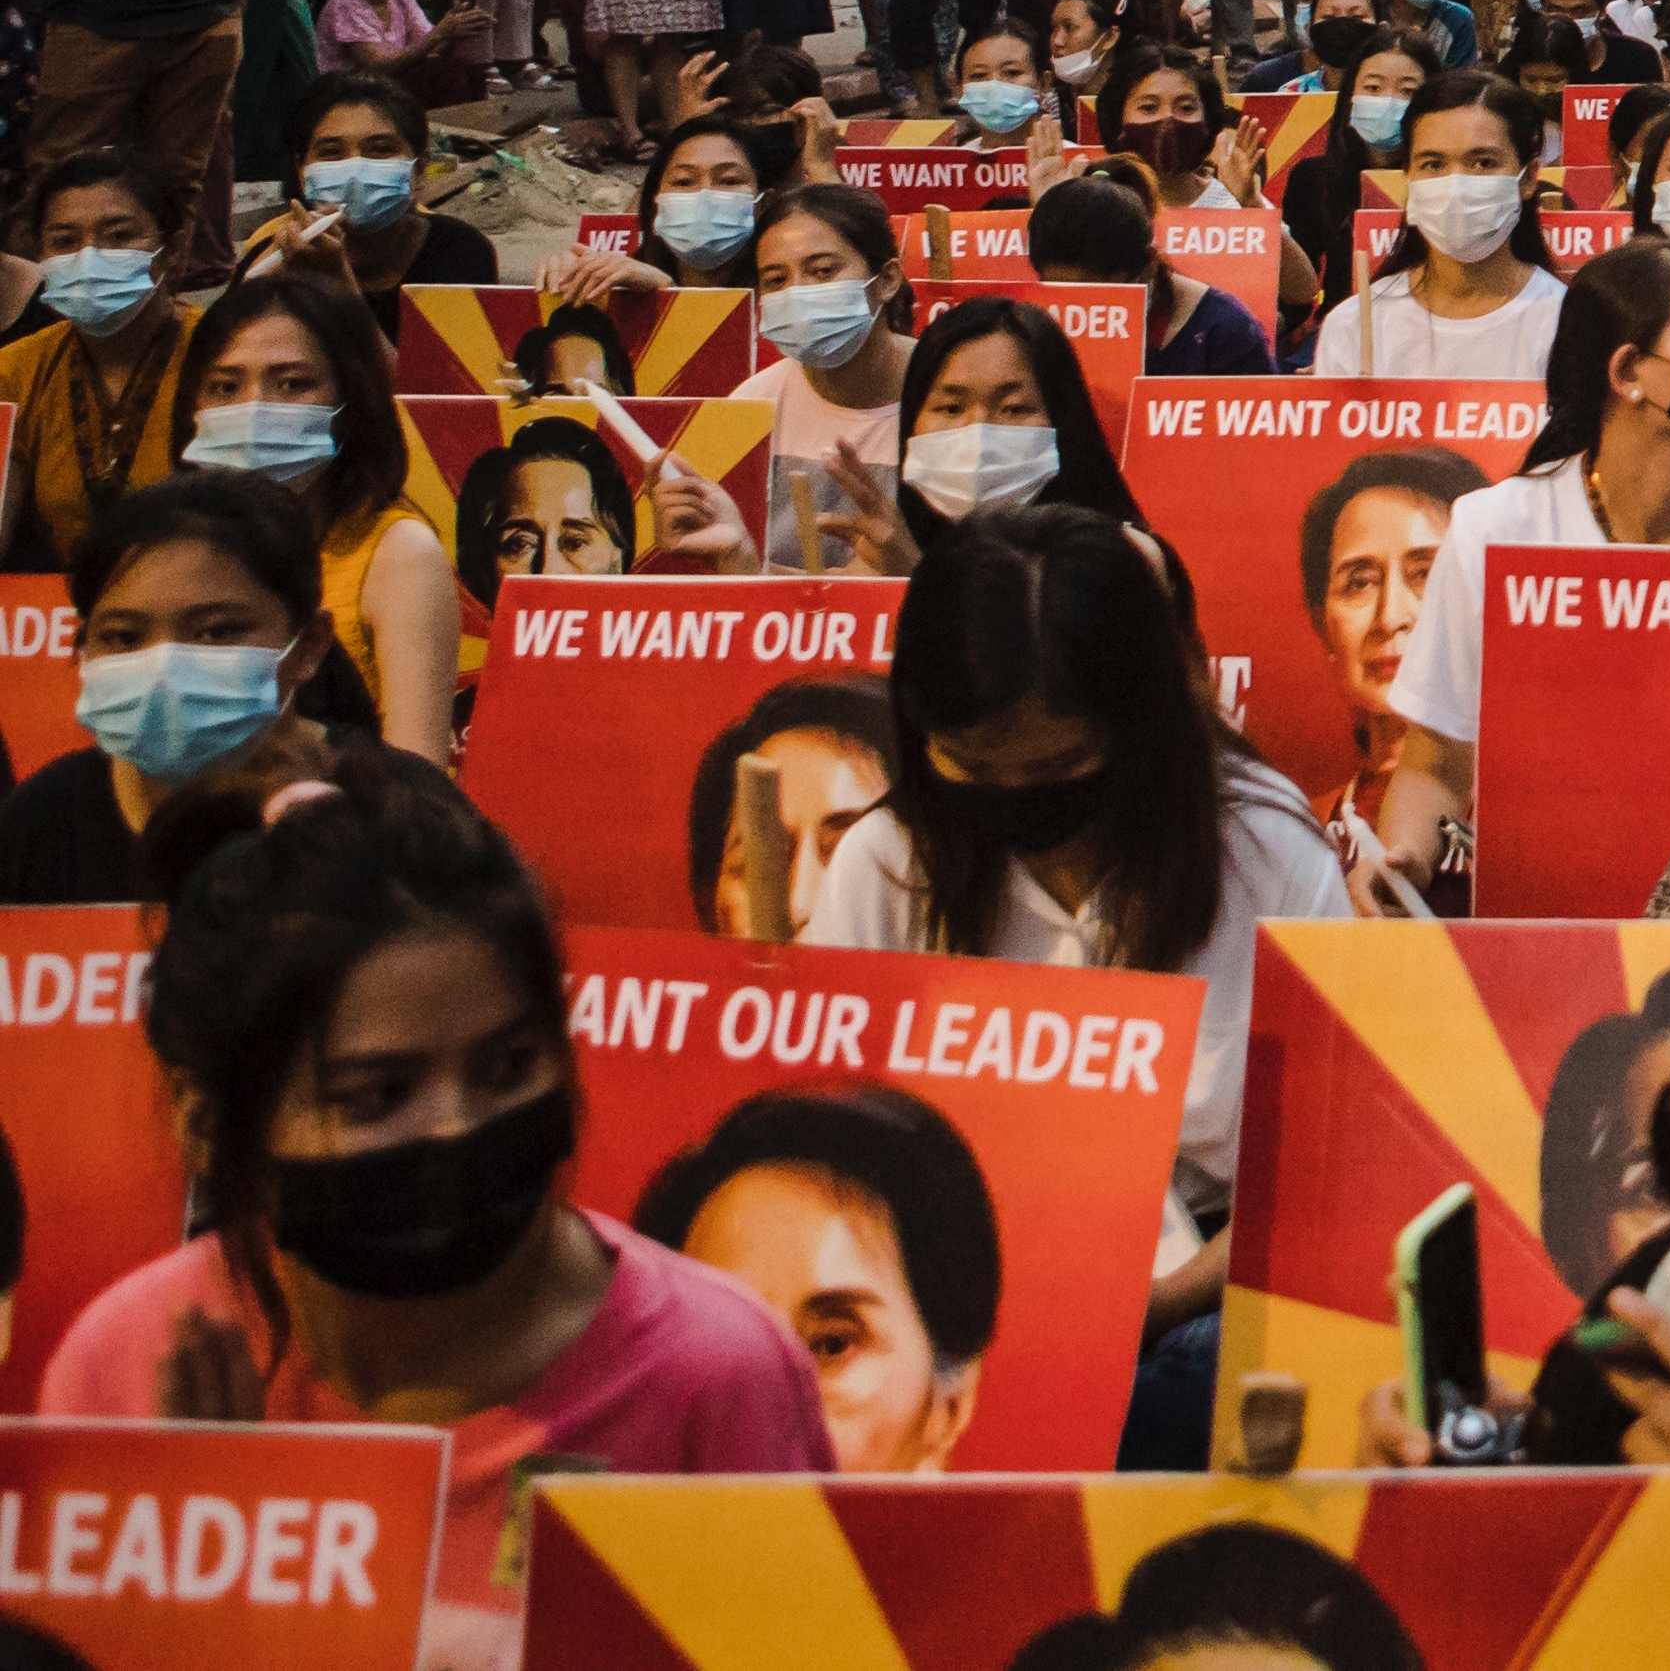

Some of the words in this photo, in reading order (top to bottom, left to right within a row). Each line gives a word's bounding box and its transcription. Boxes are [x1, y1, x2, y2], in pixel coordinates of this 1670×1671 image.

[1574, 97, 1609, 121] WE
[841, 162, 881, 187] WE
[888, 163, 967, 188] WANT
[589, 229, 632, 255] WE
[1165, 225, 1266, 256] EADER
[1147, 398, 1206, 437] WE
[1215, 398, 1331, 439] WANT
[1337, 400, 1423, 440] OUR
[1506, 574, 1584, 628] WE
[513, 608, 589, 659] WE
[601, 609, 745, 660] WANT
[752, 610, 857, 663] OUR
[568, 972, 708, 1053] ANT
[718, 986, 869, 1068] OUR
[886, 999, 1164, 1094] LEADER
[0, 1490, 379, 1608] LEADER
